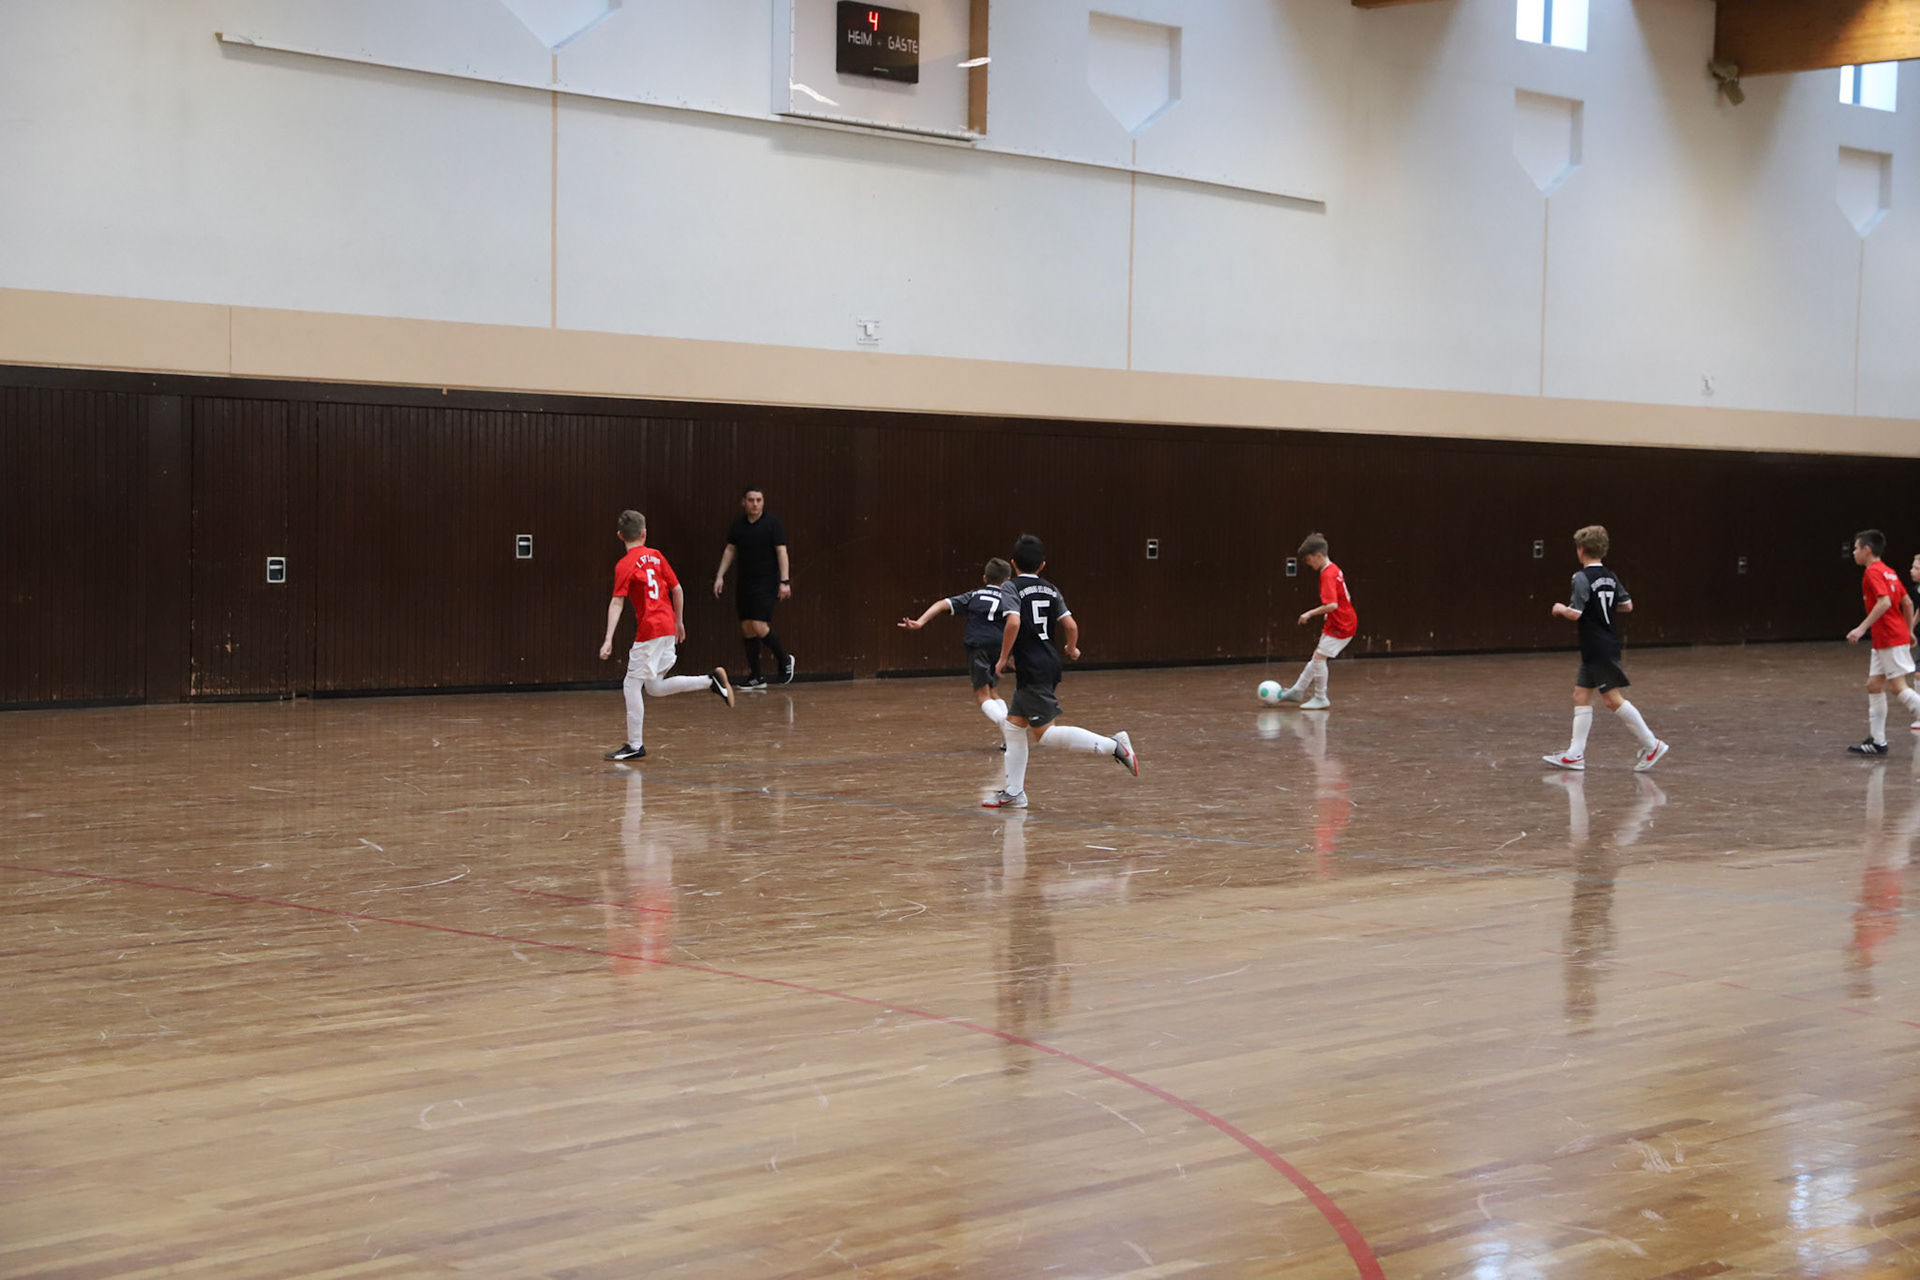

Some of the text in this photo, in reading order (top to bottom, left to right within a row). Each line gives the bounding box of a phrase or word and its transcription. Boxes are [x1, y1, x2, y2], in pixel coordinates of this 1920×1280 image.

[868, 10, 879, 31] 4
[848, 29, 872, 46] HEIM
[646, 568, 659, 600] 5
[979, 595, 1000, 621] 7
[1031, 600, 1051, 641] 5
[1597, 590, 1615, 625] 17
